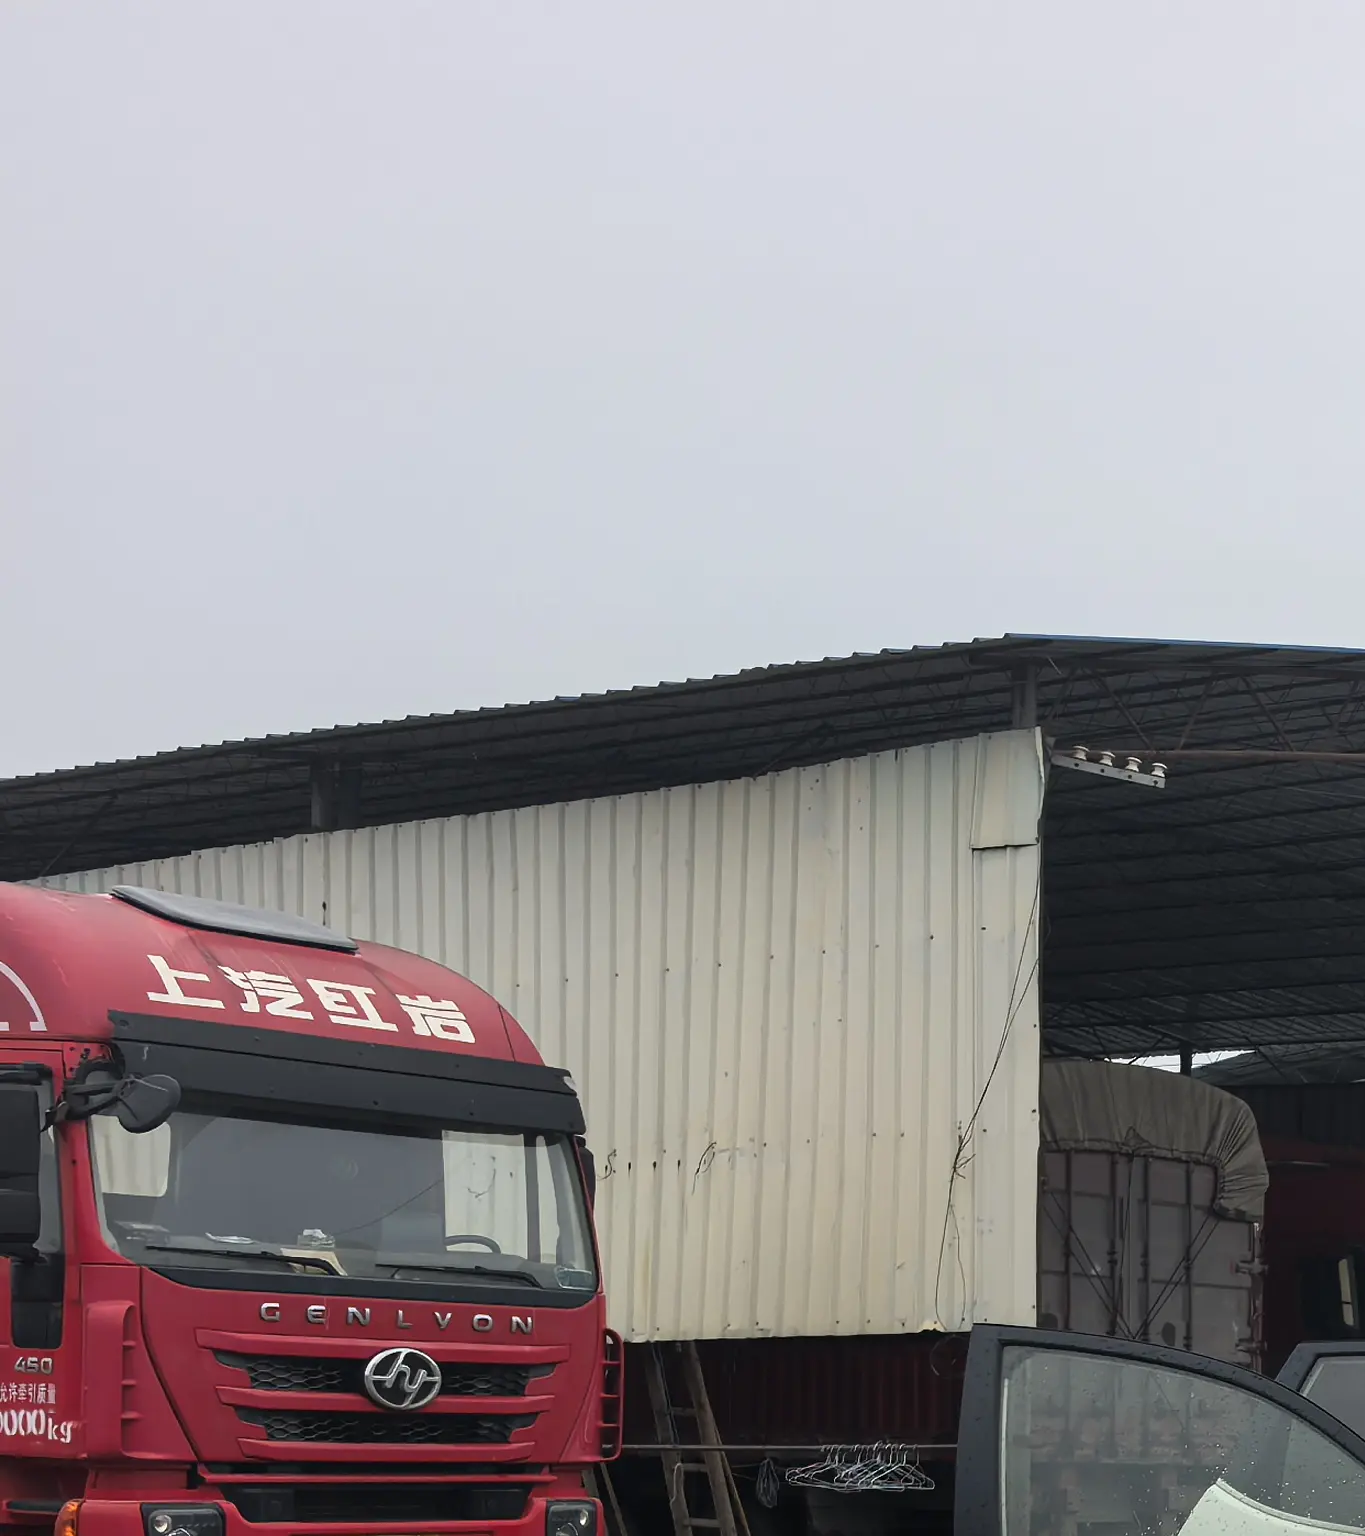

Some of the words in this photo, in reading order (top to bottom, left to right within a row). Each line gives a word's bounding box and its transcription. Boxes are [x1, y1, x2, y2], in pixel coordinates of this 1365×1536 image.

[147, 954, 476, 1044] 上汽红岩
[259, 1302, 533, 1335] GENLVON
[14, 1356, 53, 1374] 450
